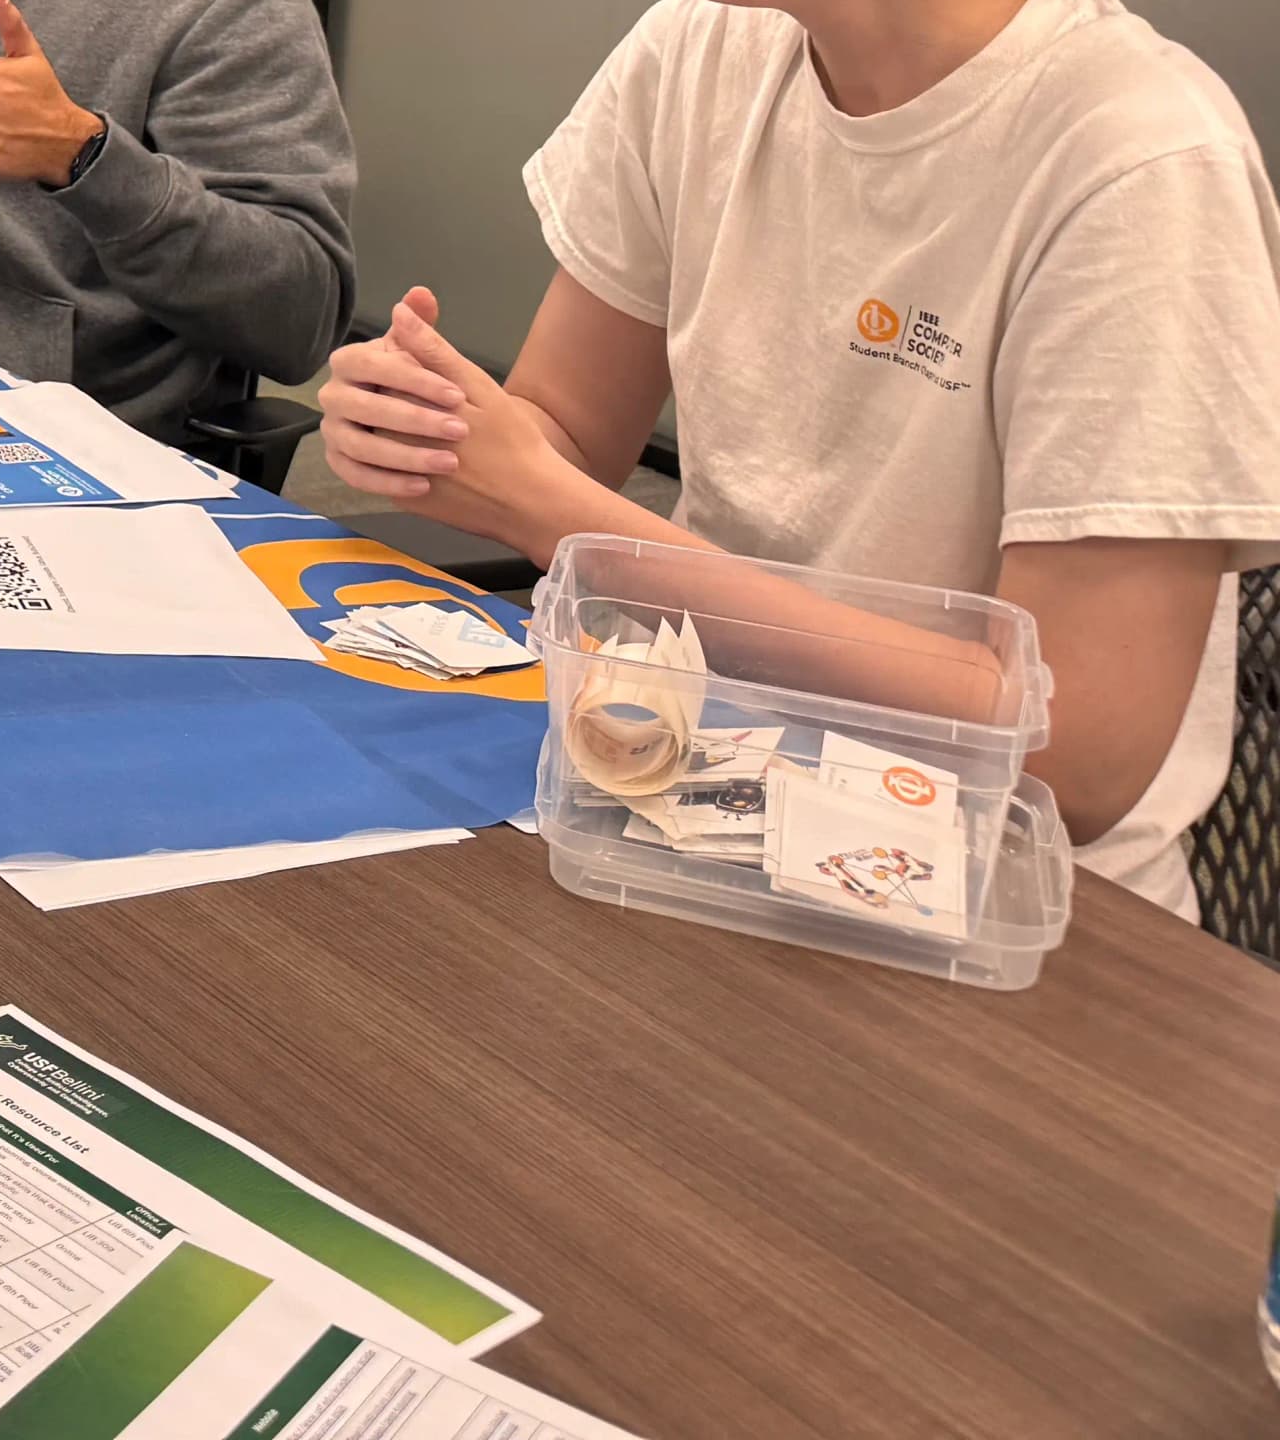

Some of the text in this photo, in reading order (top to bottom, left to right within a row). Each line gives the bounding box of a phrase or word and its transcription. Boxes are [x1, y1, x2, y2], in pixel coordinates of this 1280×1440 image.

[919, 310, 940, 327] IEEE
[913, 323, 962, 357] COMPR
[849, 342, 890, 361] Student
[893, 353, 920, 371] Branch
[0, 1098, 60, 1136] Resource
[61, 1136, 89, 1154] List
[24, 1141, 46, 1155] Used
[43, 1153, 59, 1163] For
[125, 1210, 161, 1233] Location
[134, 1206, 159, 1223] Office
[16, 1294, 38, 1309] Floor
[252, 1408, 278, 1432] Website
